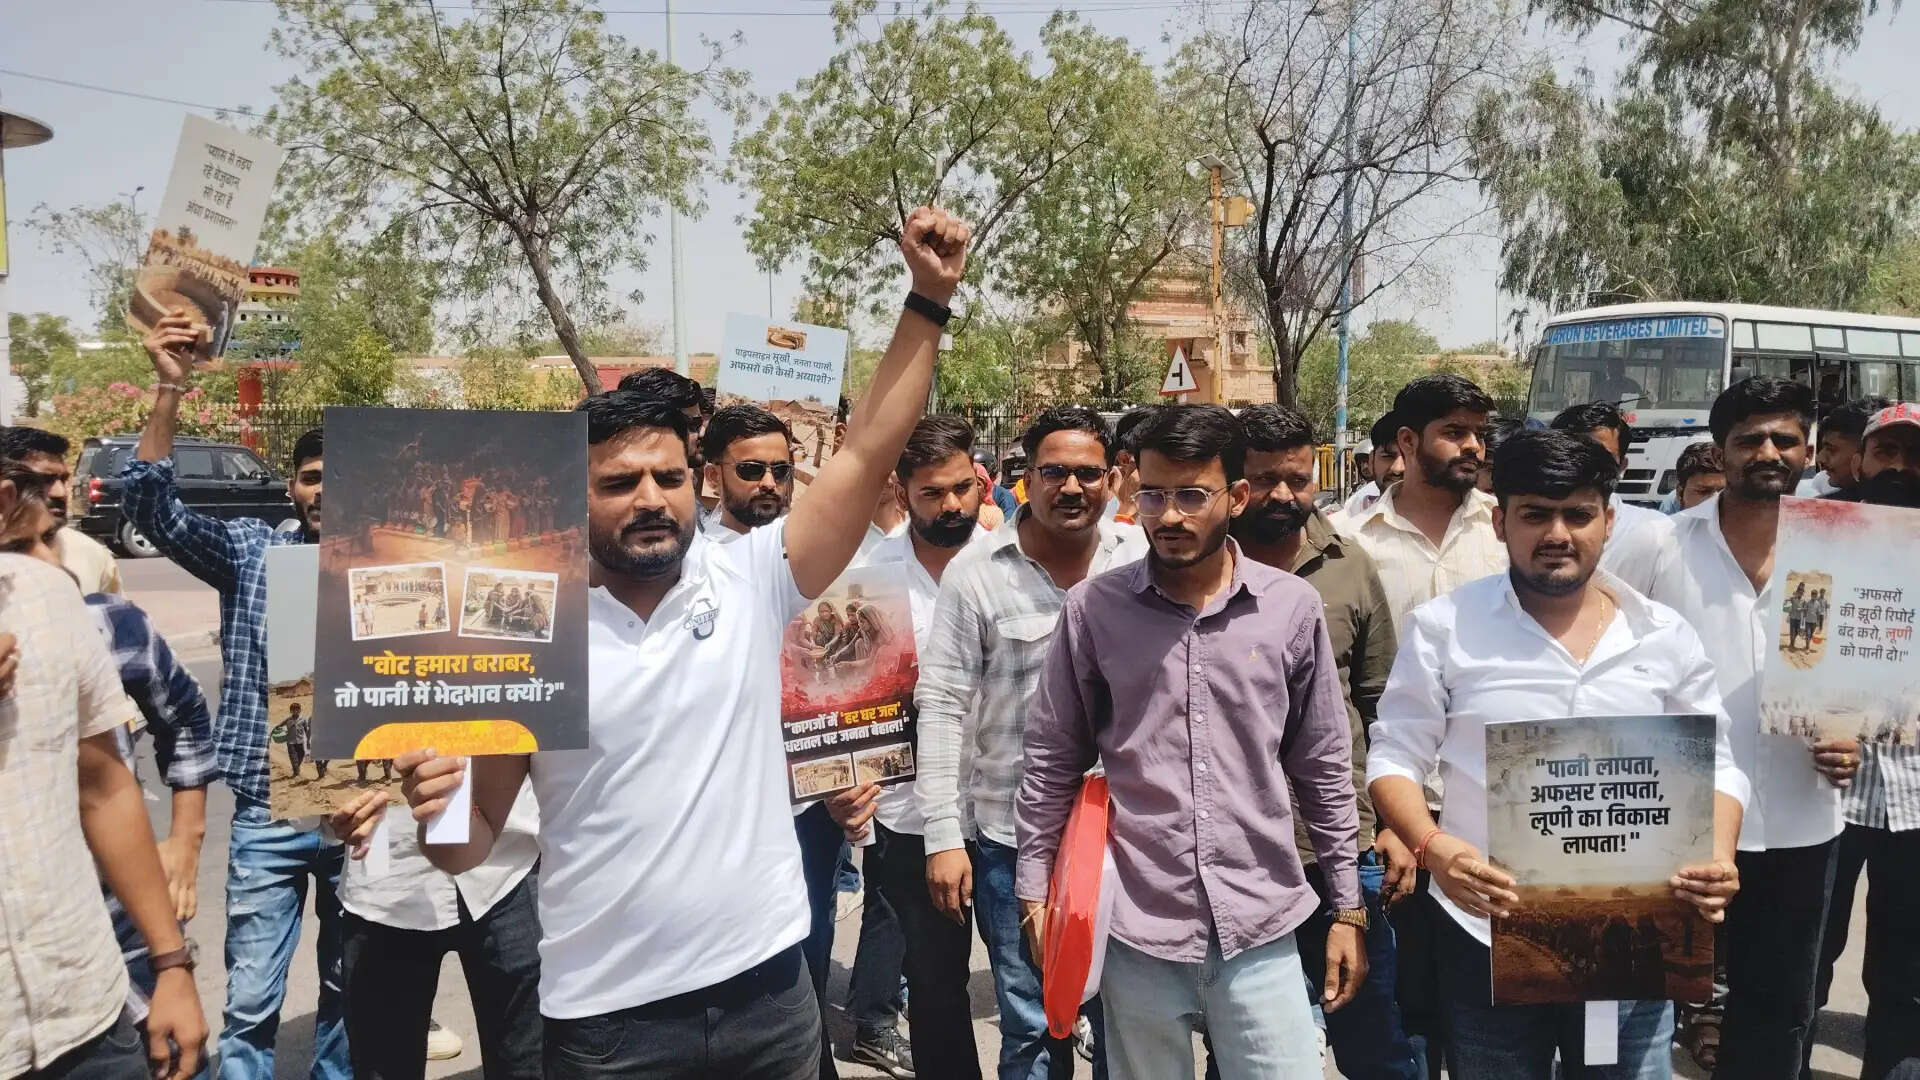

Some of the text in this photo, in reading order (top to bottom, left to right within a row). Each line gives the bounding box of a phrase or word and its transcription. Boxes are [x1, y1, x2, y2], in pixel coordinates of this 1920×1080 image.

[214, 190, 227, 205] रहा
[1584, 319, 1652, 341] BEVERAGES
[1655, 316, 1709, 337] LIMITED
[762, 364, 774, 375] की
[775, 366, 794, 378] कैसी
[793, 358, 812, 368] जनता
[1854, 587, 1903, 603] "अफसरों
[1840, 602, 1916, 624] की झूठी रिपोर्ट
[1838, 622, 1913, 645] बंद करो, लूणी
[1840, 642, 1855, 656] को
[1858, 644, 1884, 659] पानी
[363, 650, 536, 677] "वोट हमारा बराबर,
[334, 677, 565, 707] तो पानी में भेदभाव क्यों?"
[784, 713, 826, 734] "कागजों
[826, 711, 839, 727] में
[840, 711, 860, 724] 'हर
[860, 708, 876, 721] घर
[822, 732, 838, 745] पर
[840, 727, 870, 742] जनता
[1535, 753, 1660, 778] "पानी लापता,
[1530, 781, 1664, 803] अफसर लापता,
[1529, 803, 1671, 836] लूणी का विकास
